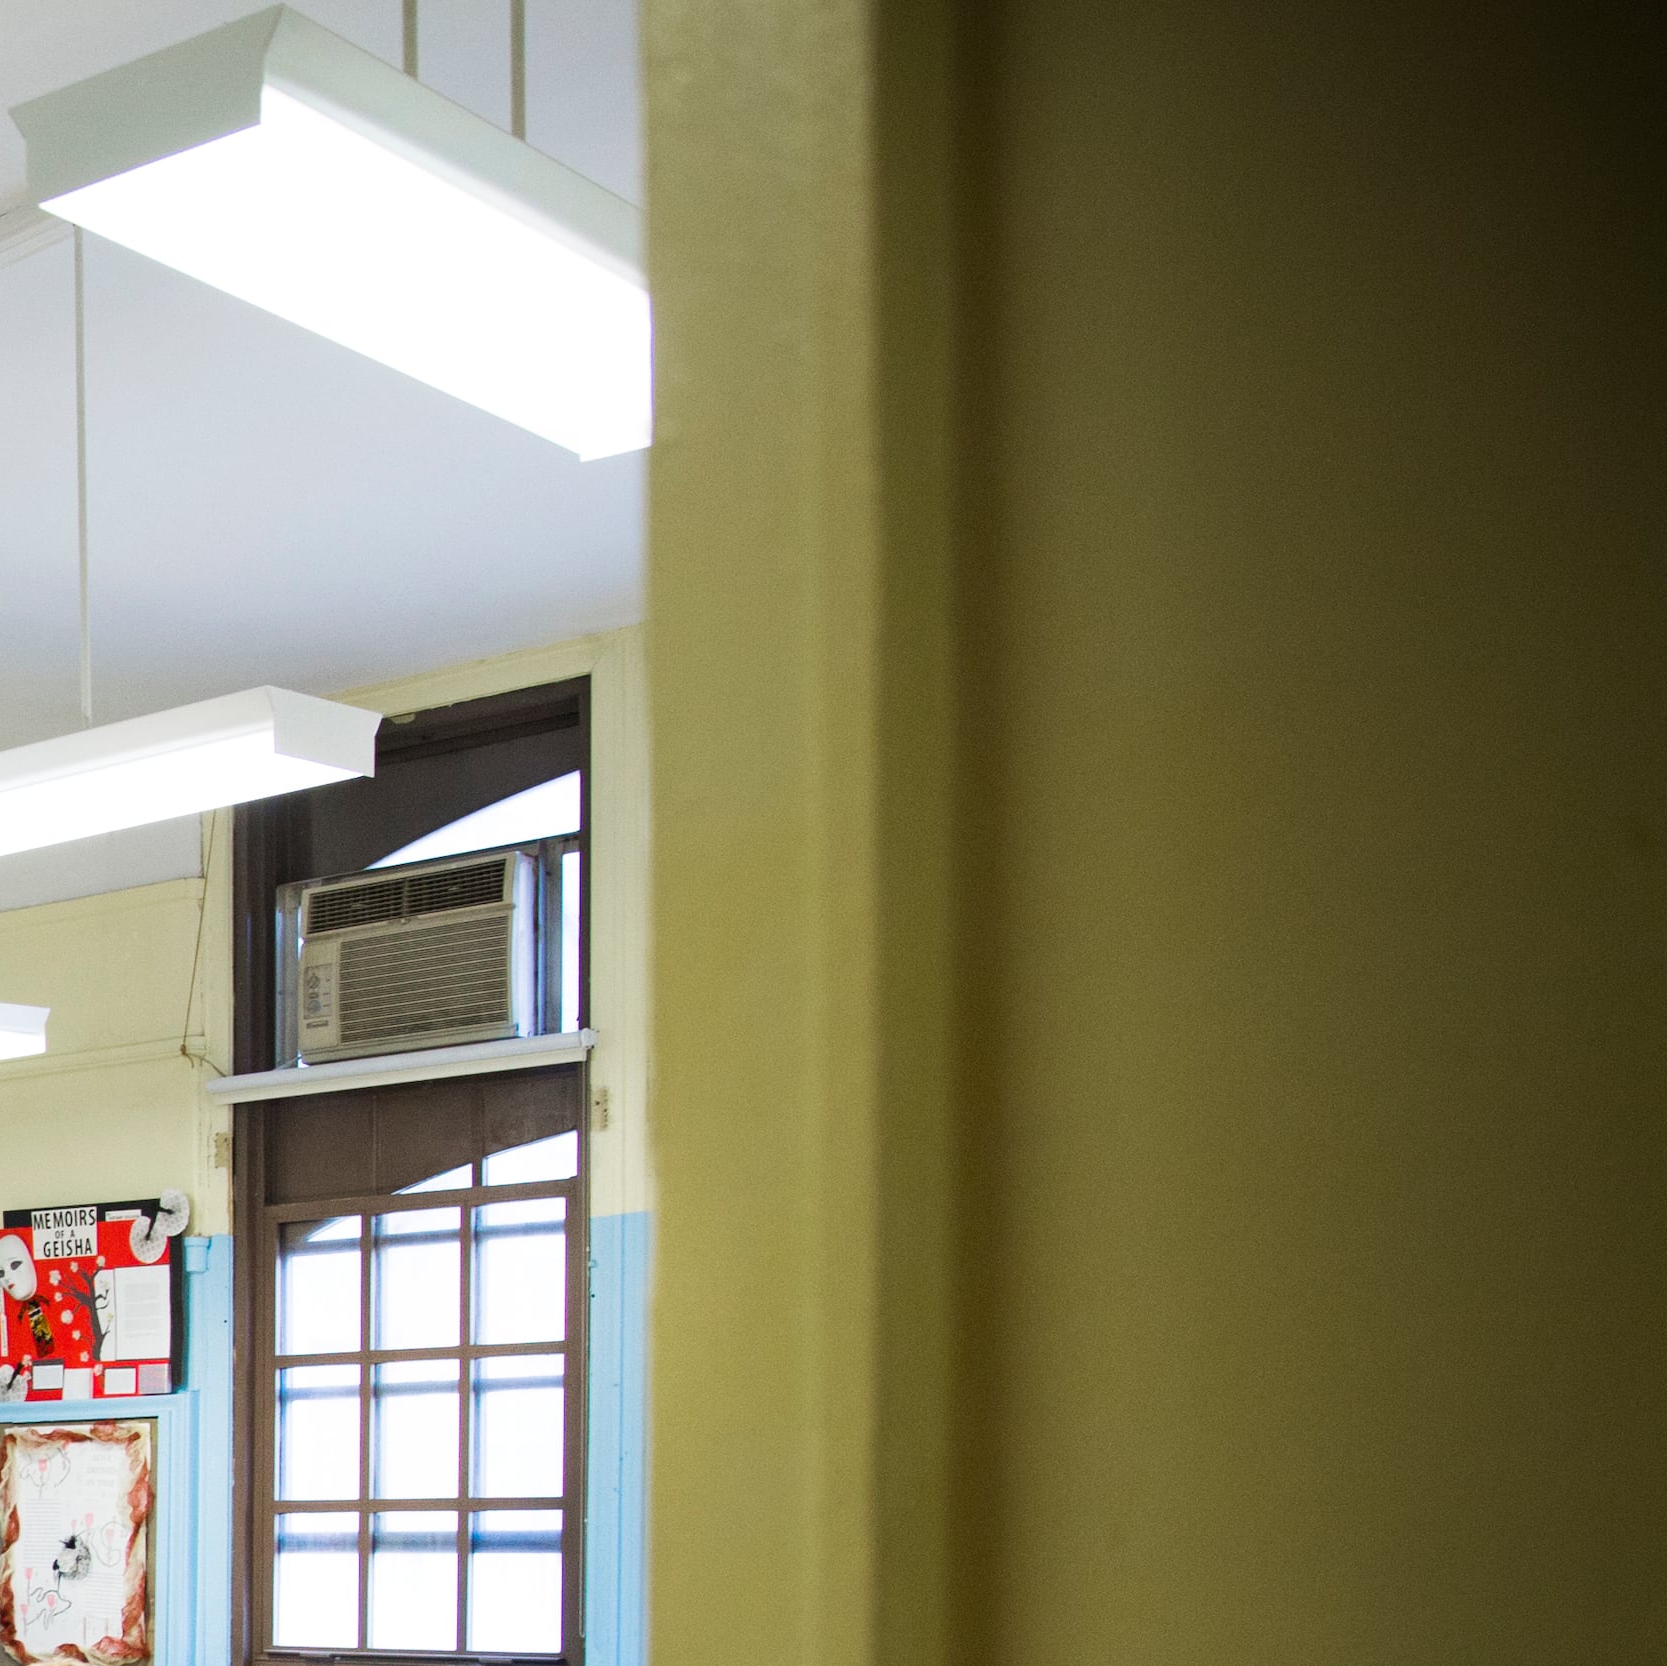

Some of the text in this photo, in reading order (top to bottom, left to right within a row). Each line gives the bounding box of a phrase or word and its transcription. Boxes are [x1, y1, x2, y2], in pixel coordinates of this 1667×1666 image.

[33, 1209, 96, 1230] MEMOIRS
[55, 1230, 64, 1239] OF
[43, 1238, 93, 1257] GEISHA
